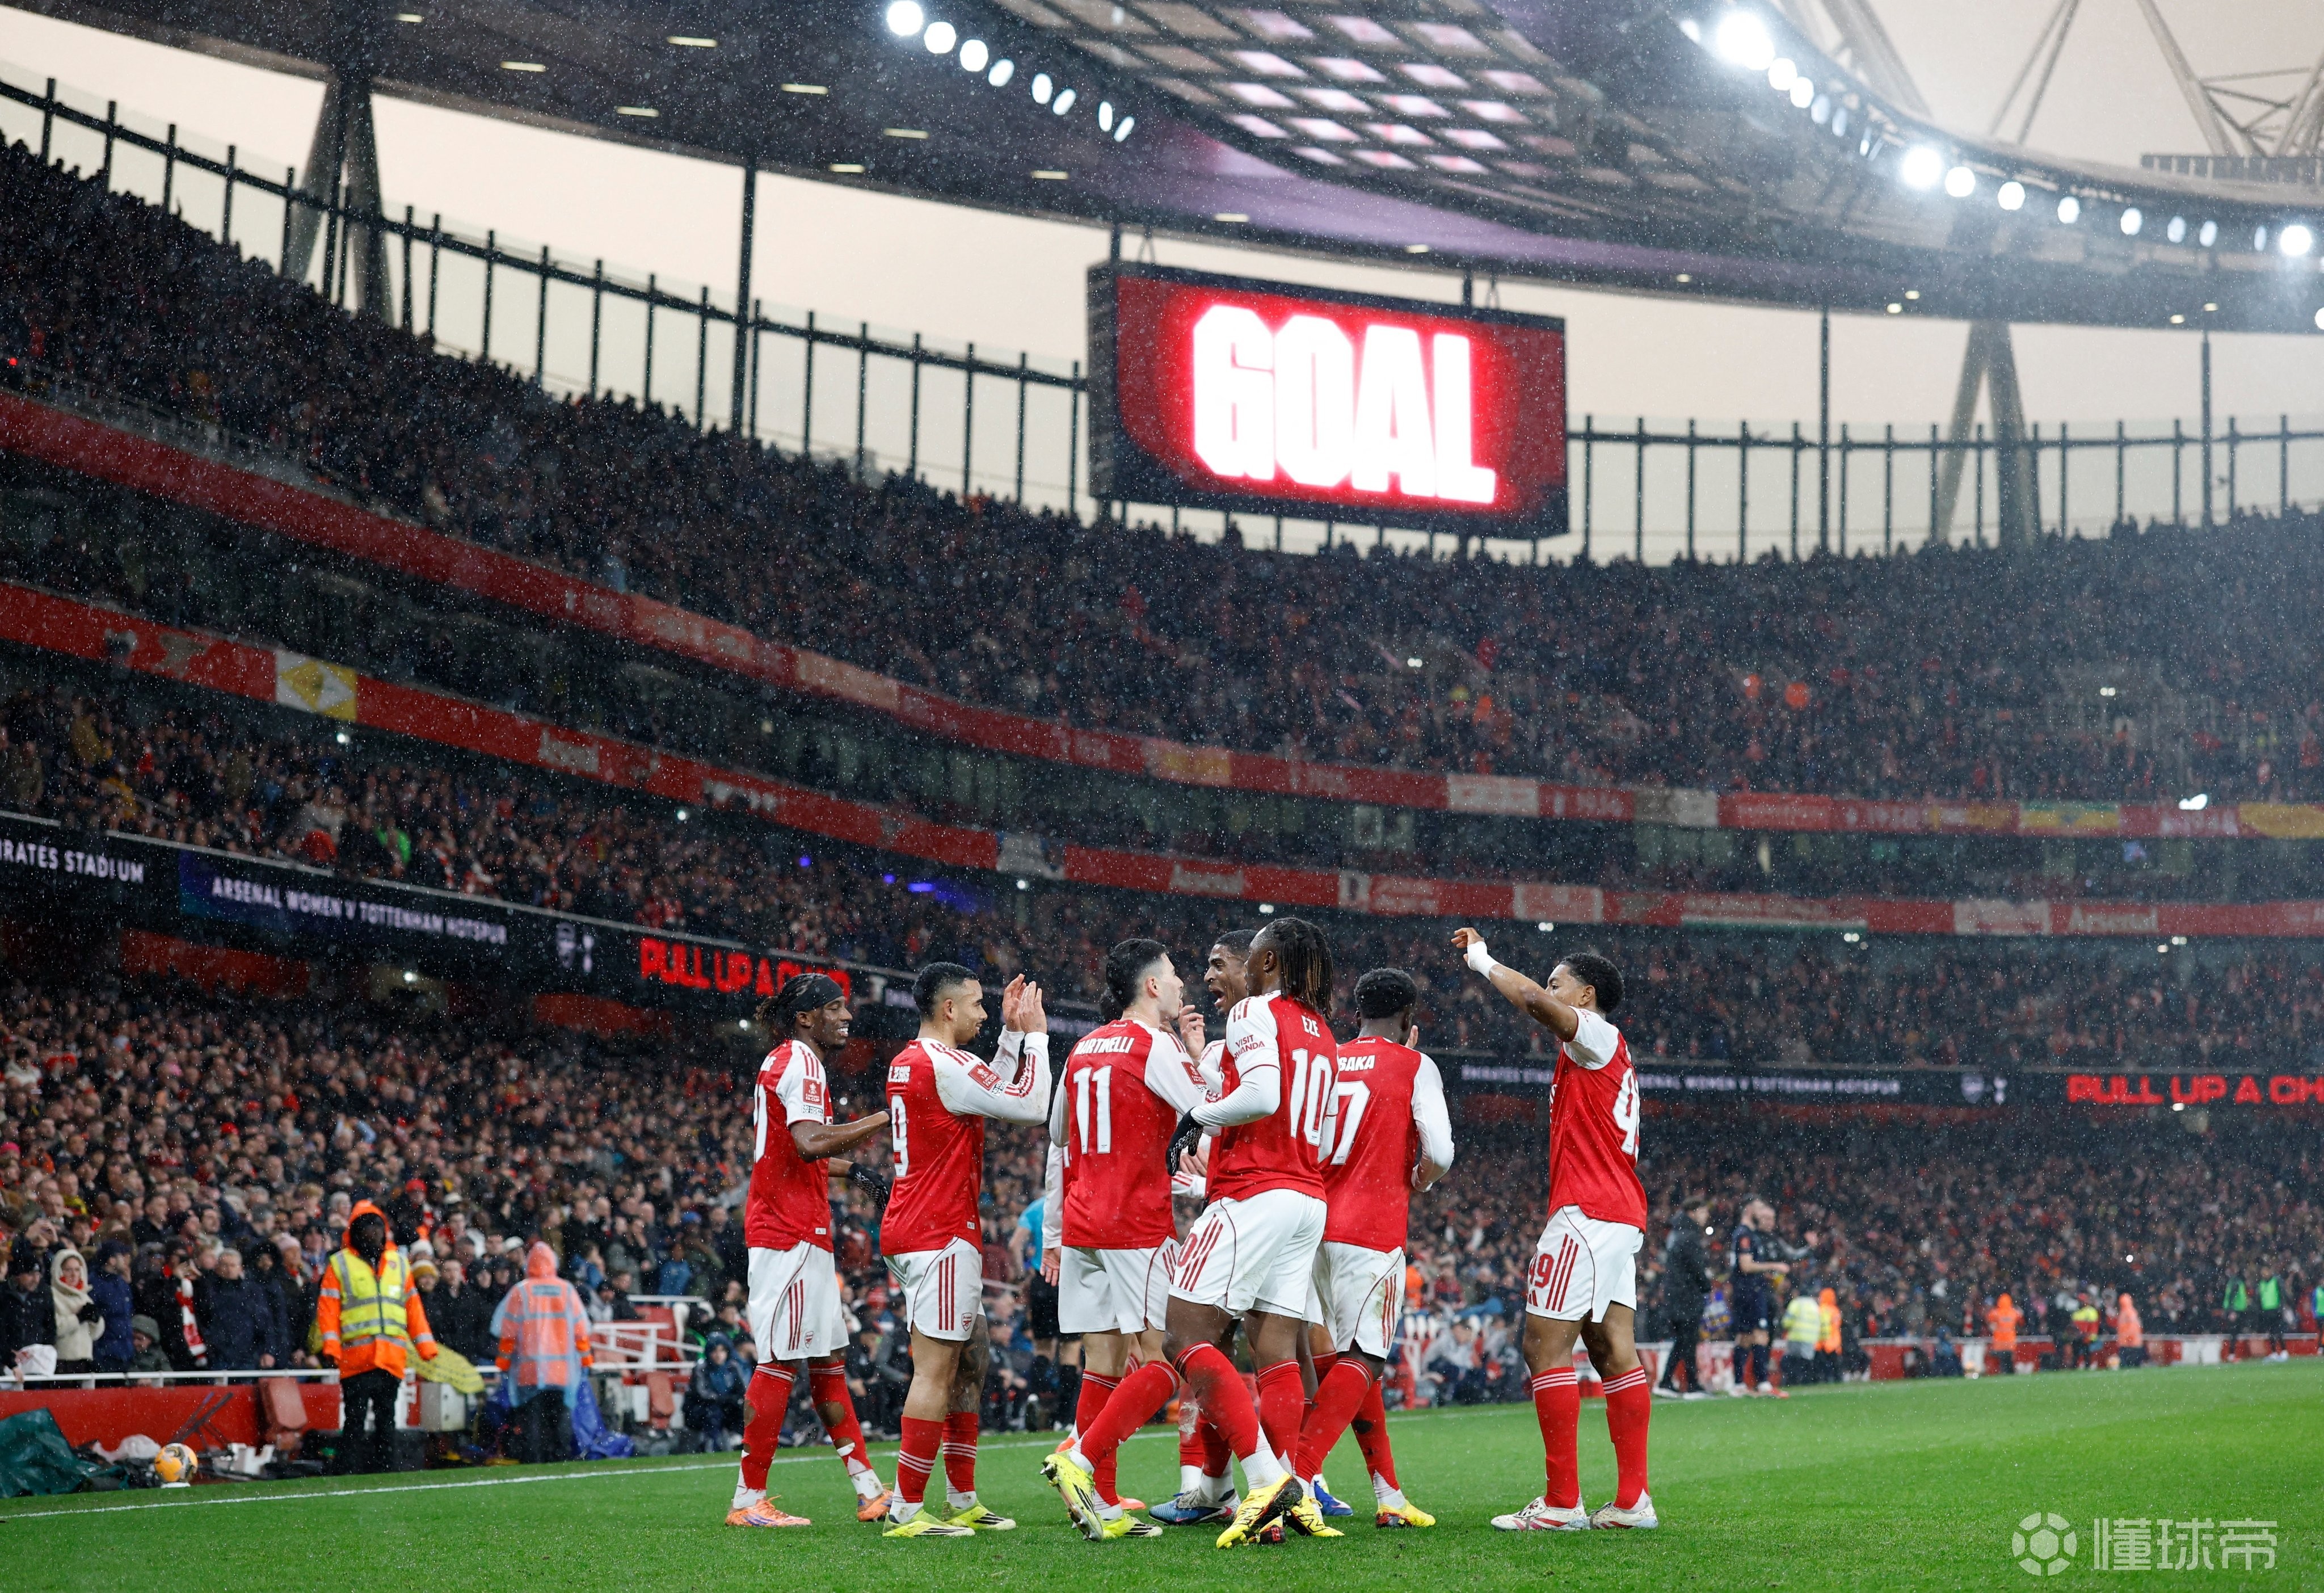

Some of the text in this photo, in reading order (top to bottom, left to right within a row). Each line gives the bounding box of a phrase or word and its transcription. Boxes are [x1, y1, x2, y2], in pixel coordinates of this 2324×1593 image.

[1193, 304, 1496, 504] GOAL
[64, 850, 144, 884] STADIUM
[212, 876, 283, 908] ARSENAL
[639, 936, 711, 990] PULL
[713, 950, 753, 994] UP
[1235, 1035, 1253, 1048] VISIT
[1301, 1015, 1321, 1038] EZE
[1073, 1036, 1135, 1057] MARTINELLI
[1233, 1041, 1265, 1061] RWANDA
[1338, 1055, 1375, 1071] SAKA
[1290, 1048, 1333, 1148] 10
[2067, 1074, 2164, 1104] PULL
[2170, 1074, 2228, 1104] UP
[2234, 1075, 2263, 1104] A
[1073, 1065, 1112, 1155] 11
[1331, 1080, 1371, 1165] 7
[891, 1095, 909, 1177] 9
[1529, 1252, 1555, 1289] 49
